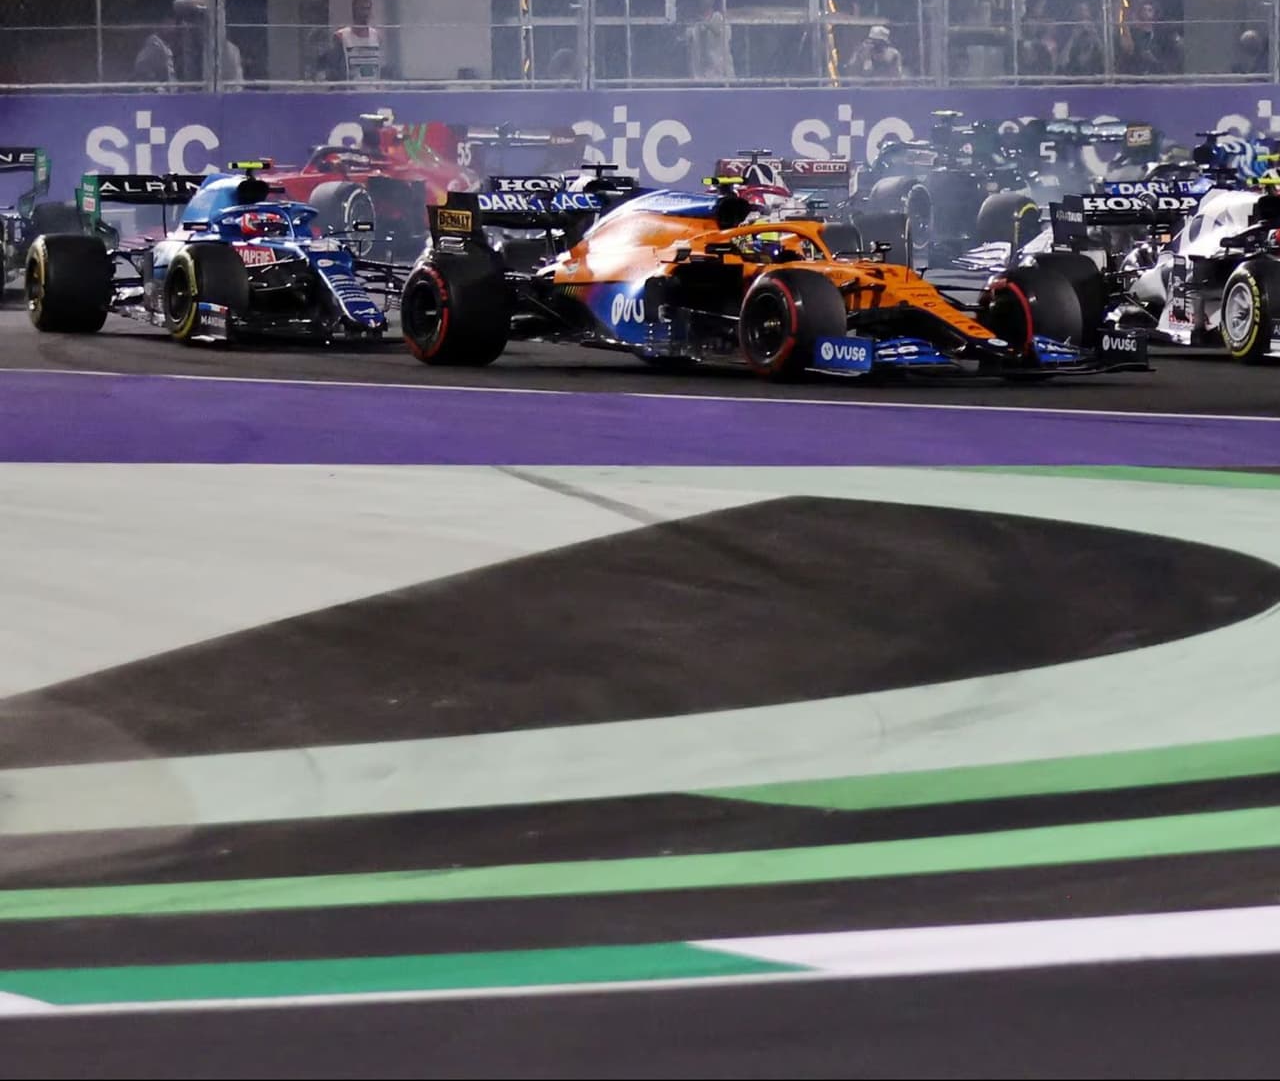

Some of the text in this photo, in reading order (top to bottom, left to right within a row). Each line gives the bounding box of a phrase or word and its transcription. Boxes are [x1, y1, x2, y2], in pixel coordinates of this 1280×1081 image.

[86, 110, 220, 175] stc
[457, 142, 473, 166] 55
[1040, 141, 1057, 164] 5
[1083, 197, 1199, 211] HONDA
